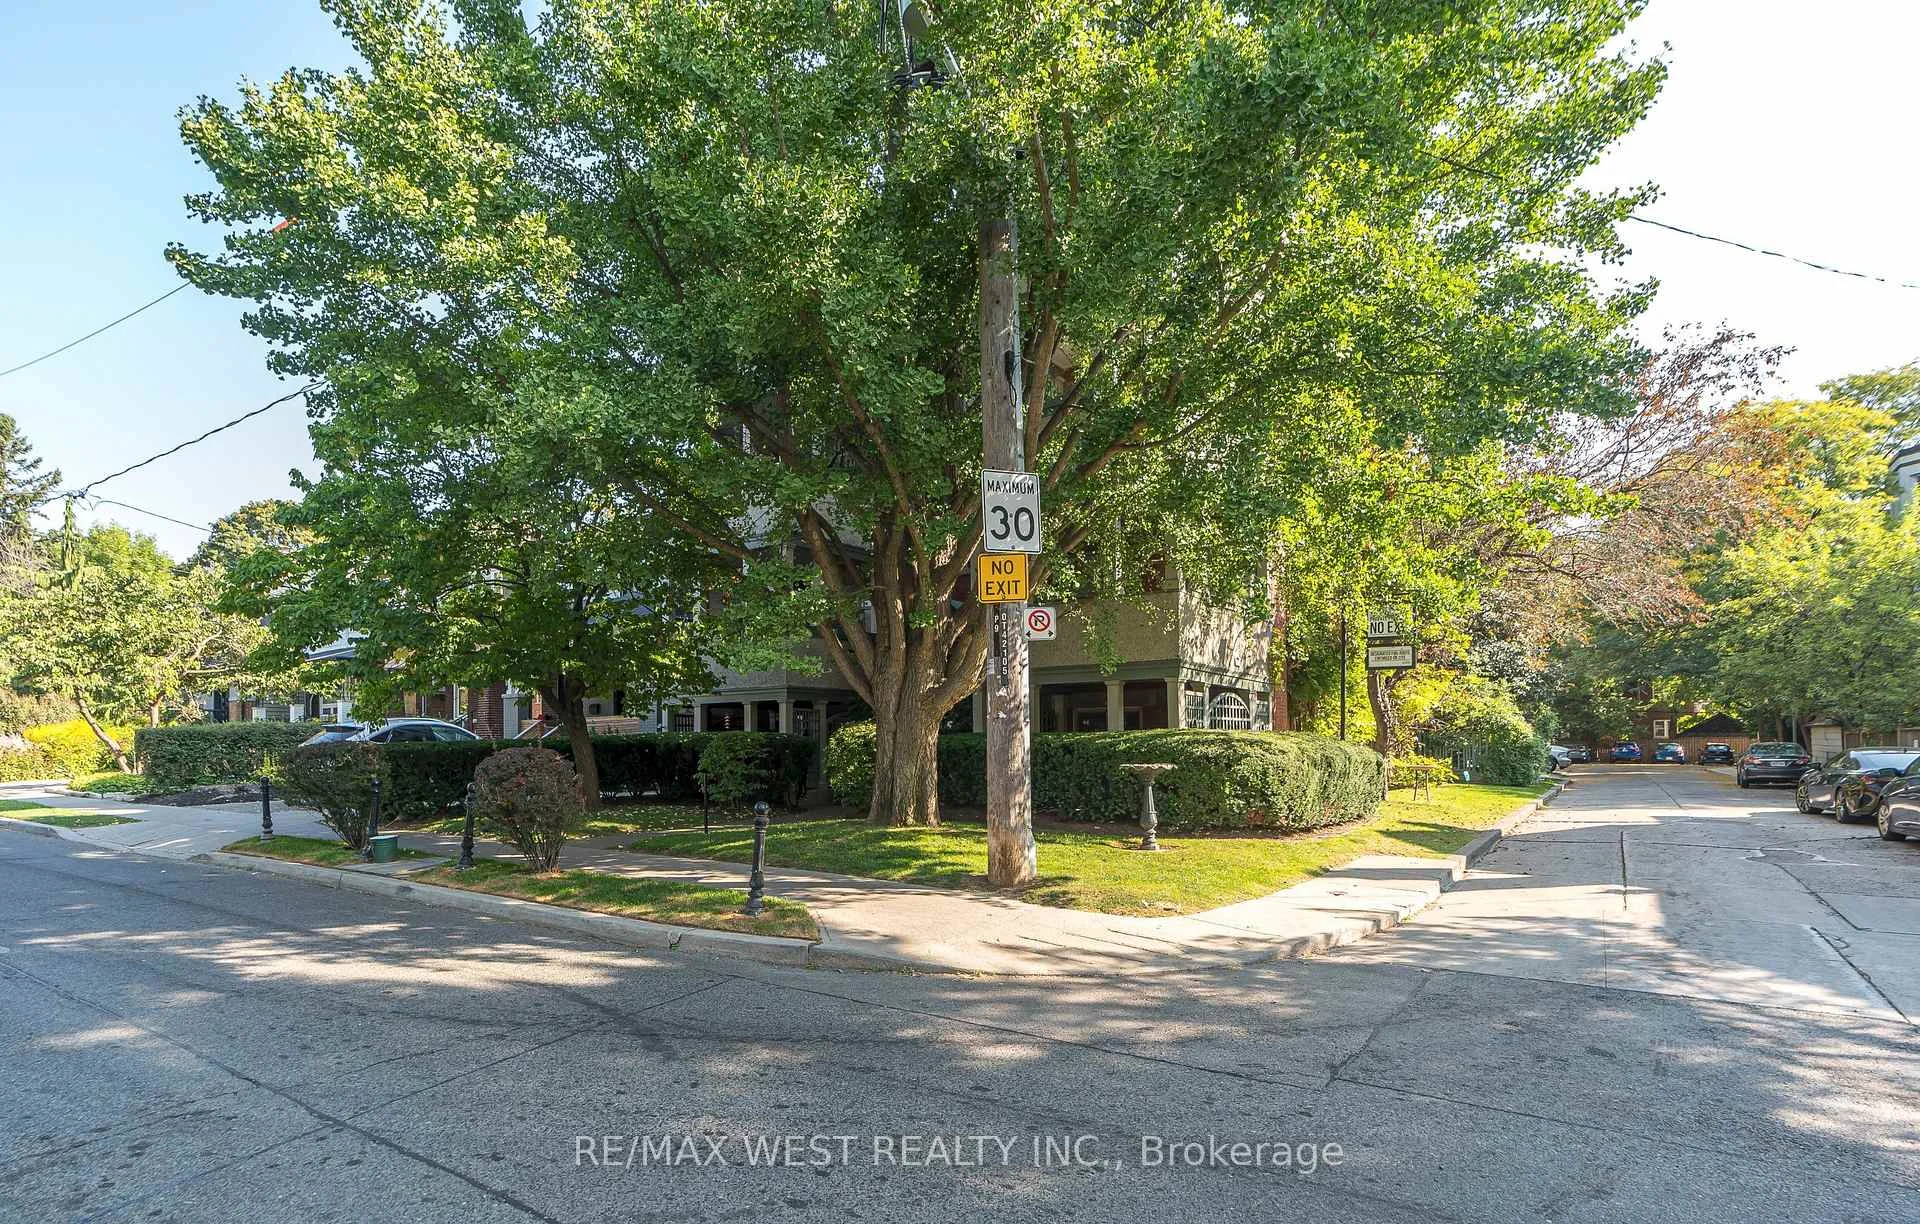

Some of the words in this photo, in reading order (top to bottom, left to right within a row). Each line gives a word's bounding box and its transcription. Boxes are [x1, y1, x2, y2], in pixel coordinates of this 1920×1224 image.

[987, 479, 1035, 495] MAXIMUM
[990, 505, 1035, 542] 30
[991, 559, 1014, 576] NO
[985, 580, 1021, 596] EXIT
[1370, 621, 1384, 634] NO
